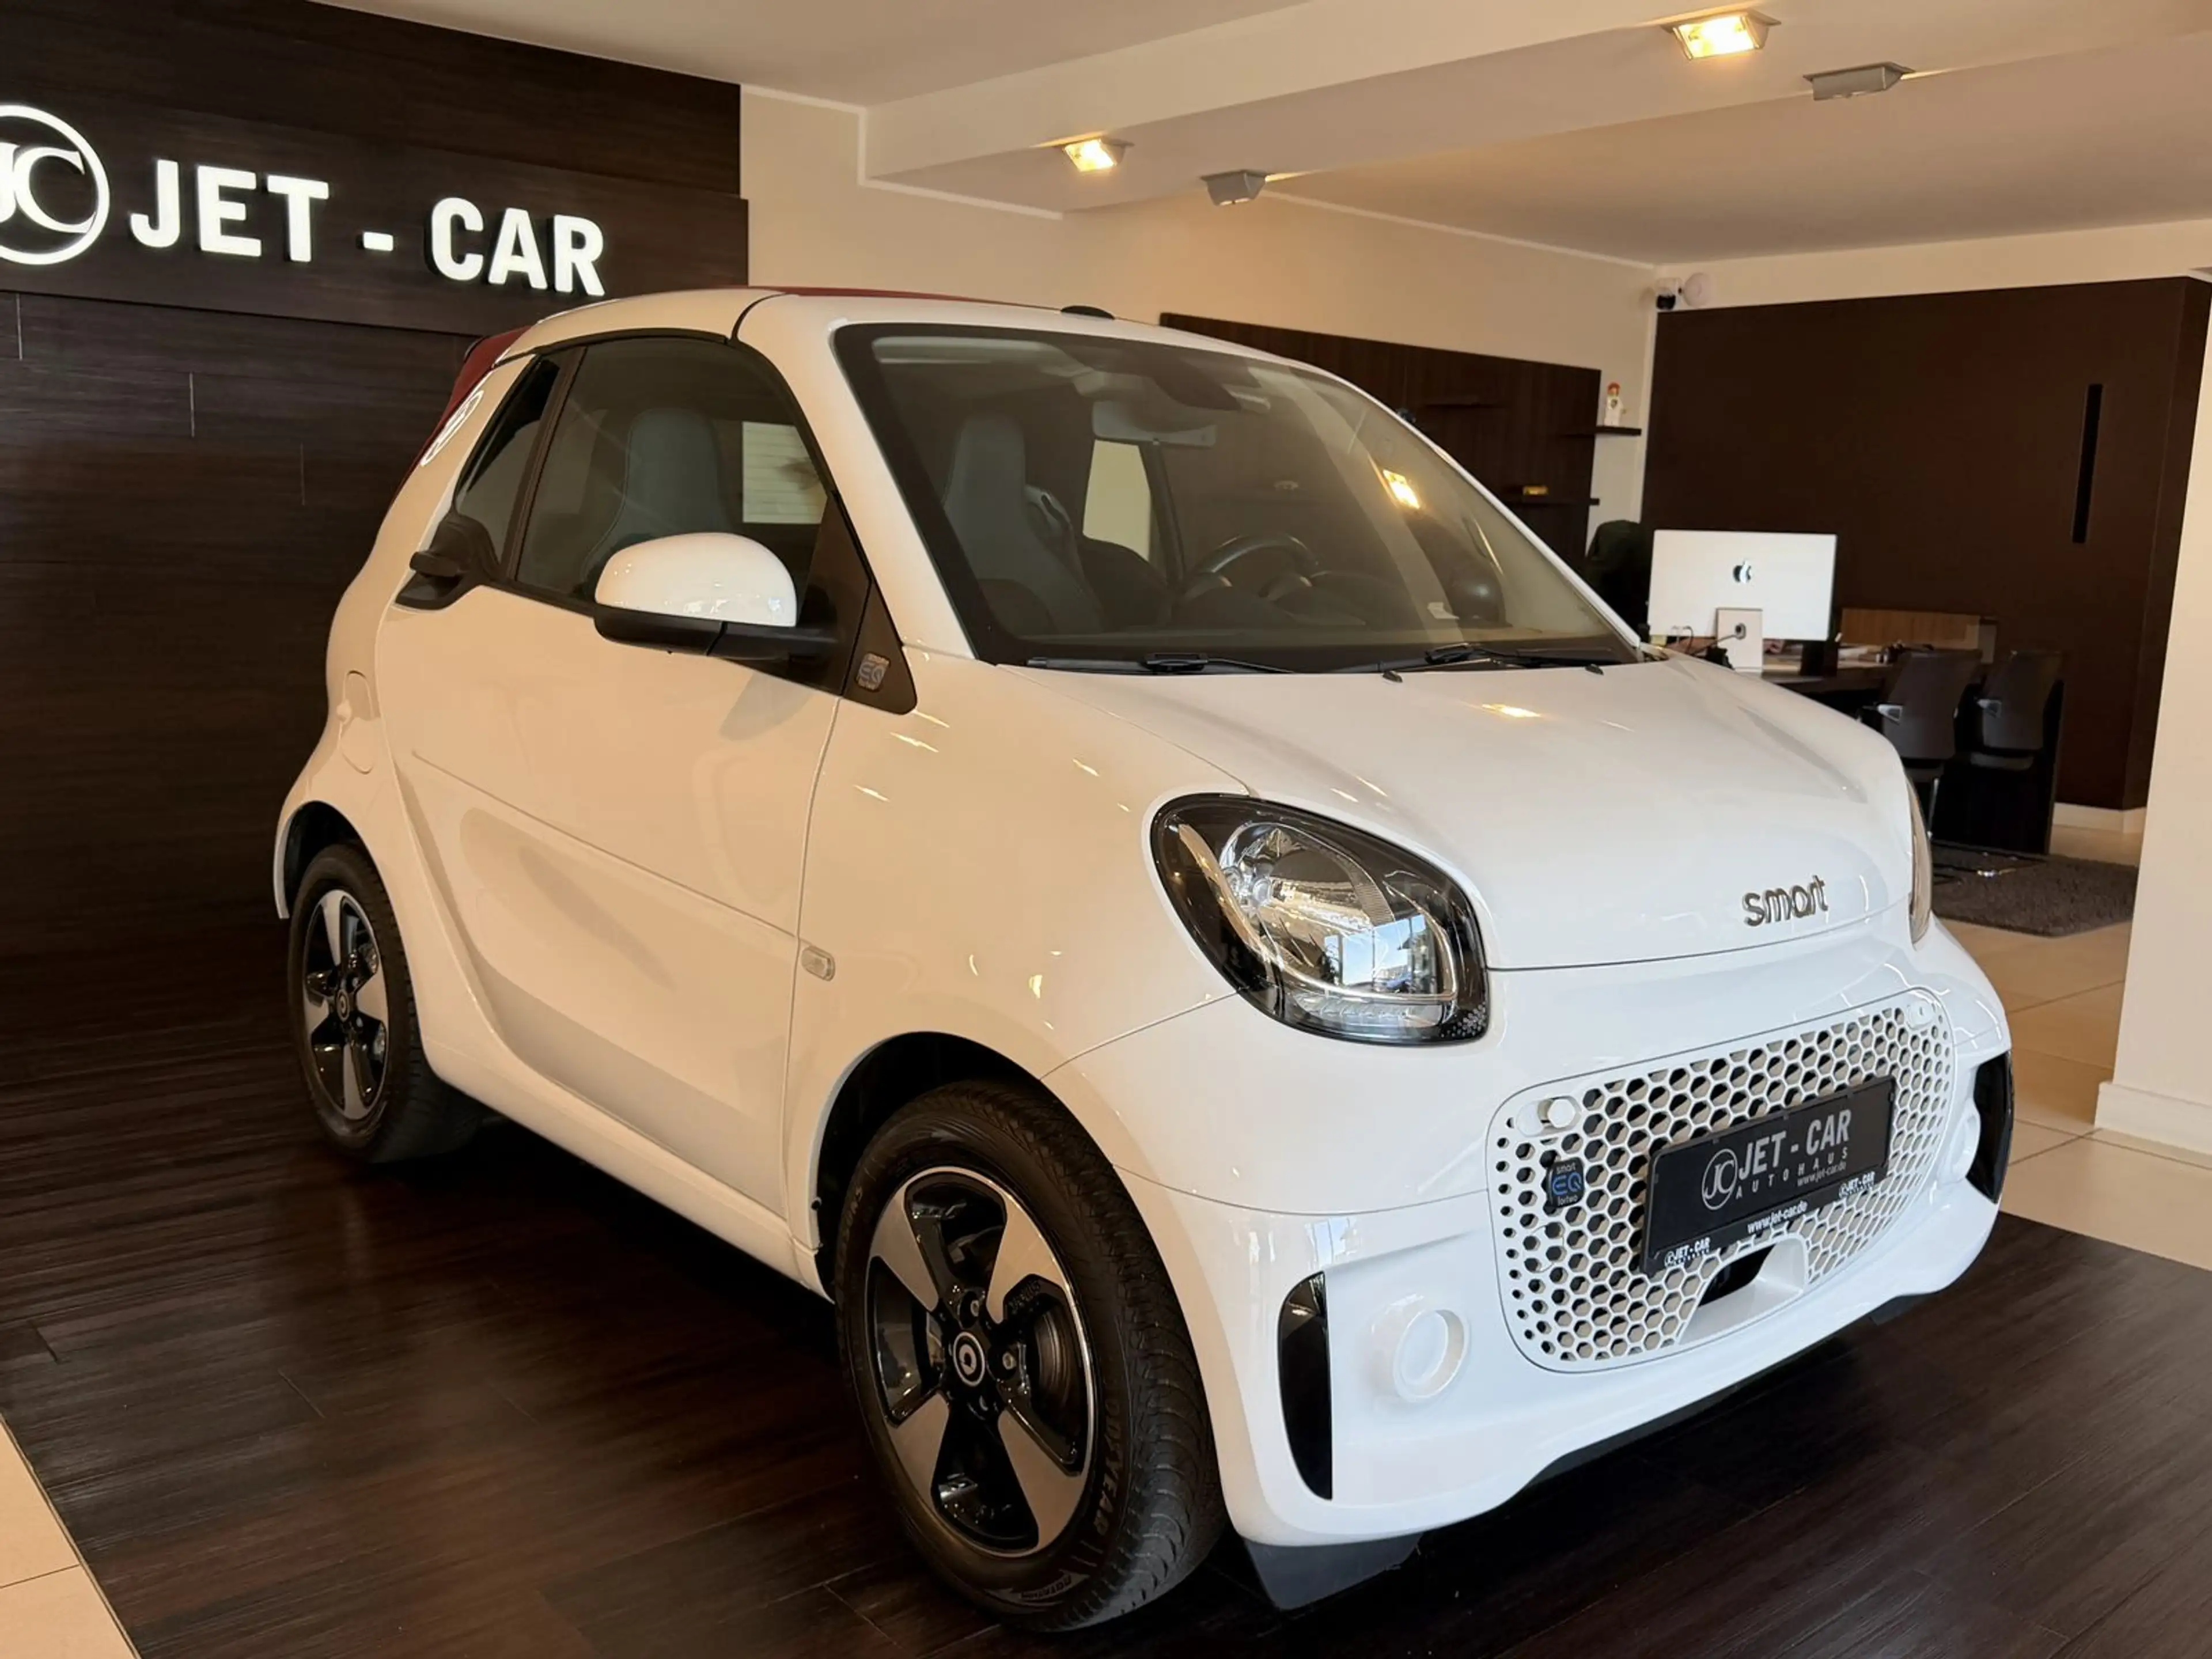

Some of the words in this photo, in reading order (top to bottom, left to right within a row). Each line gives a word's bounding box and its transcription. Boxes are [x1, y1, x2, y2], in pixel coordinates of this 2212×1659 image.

[130, 158, 329, 263] JET
[430, 196, 605, 297] CAR
[1742, 874, 1829, 927] smart
[1738, 1130, 1787, 1180] JET
[1806, 1109, 1852, 1156] CAR
[1552, 1172, 1582, 1195] EQ
[1747, 1200, 1808, 1234] www.jet-car.de
